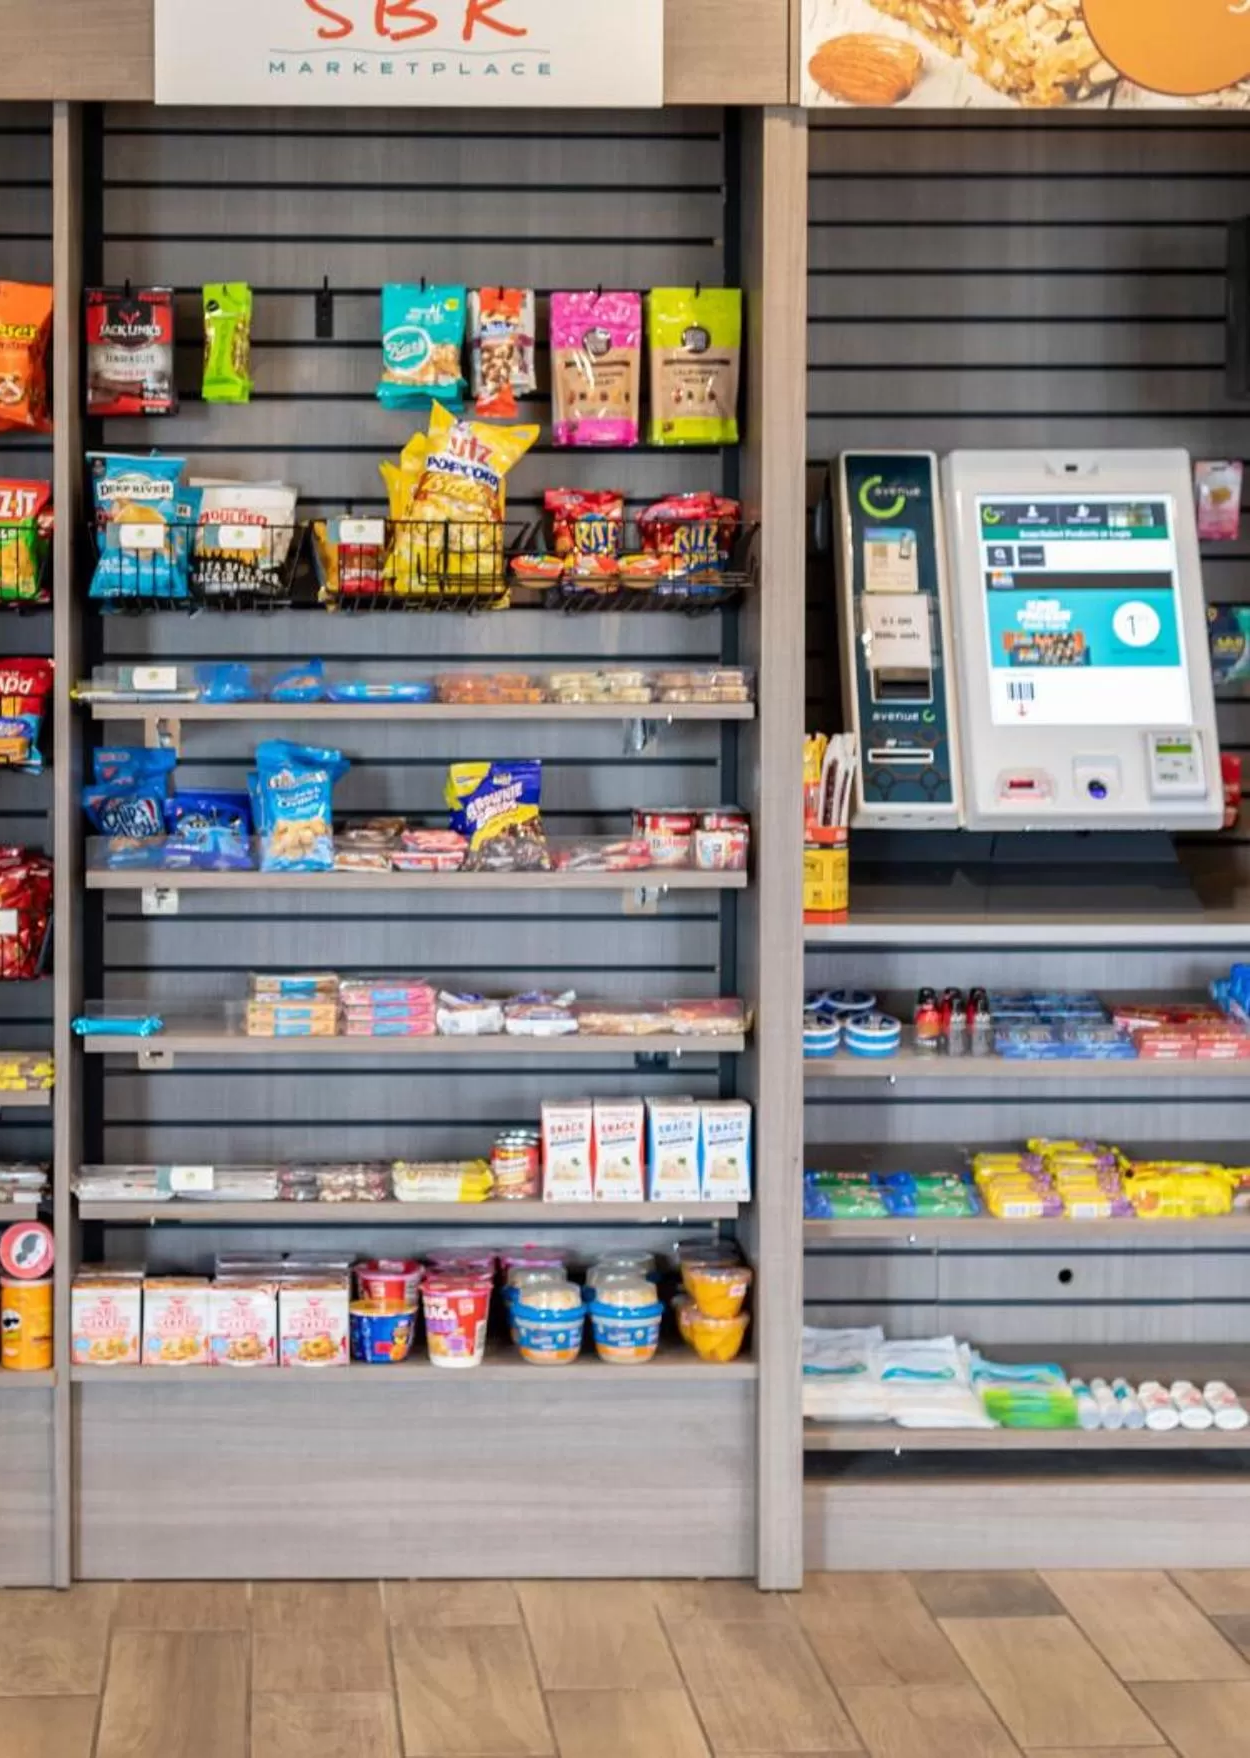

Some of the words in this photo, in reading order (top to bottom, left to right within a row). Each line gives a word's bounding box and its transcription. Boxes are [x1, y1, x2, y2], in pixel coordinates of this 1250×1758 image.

[269, 61, 551, 76] MARKETPLACE
[99, 323, 127, 338] JACK
[427, 455, 499, 489] POPCORN
[100, 482, 130, 497] DEEP
[131, 482, 171, 497] RIVER
[874, 486, 921, 497] avenue
[872, 711, 919, 722] avenue
[550, 1121, 585, 1134] SNACK
[601, 1120, 636, 1134] SNACK
[658, 1120, 693, 1134] SNACK
[708, 1120, 744, 1134] SNACK
